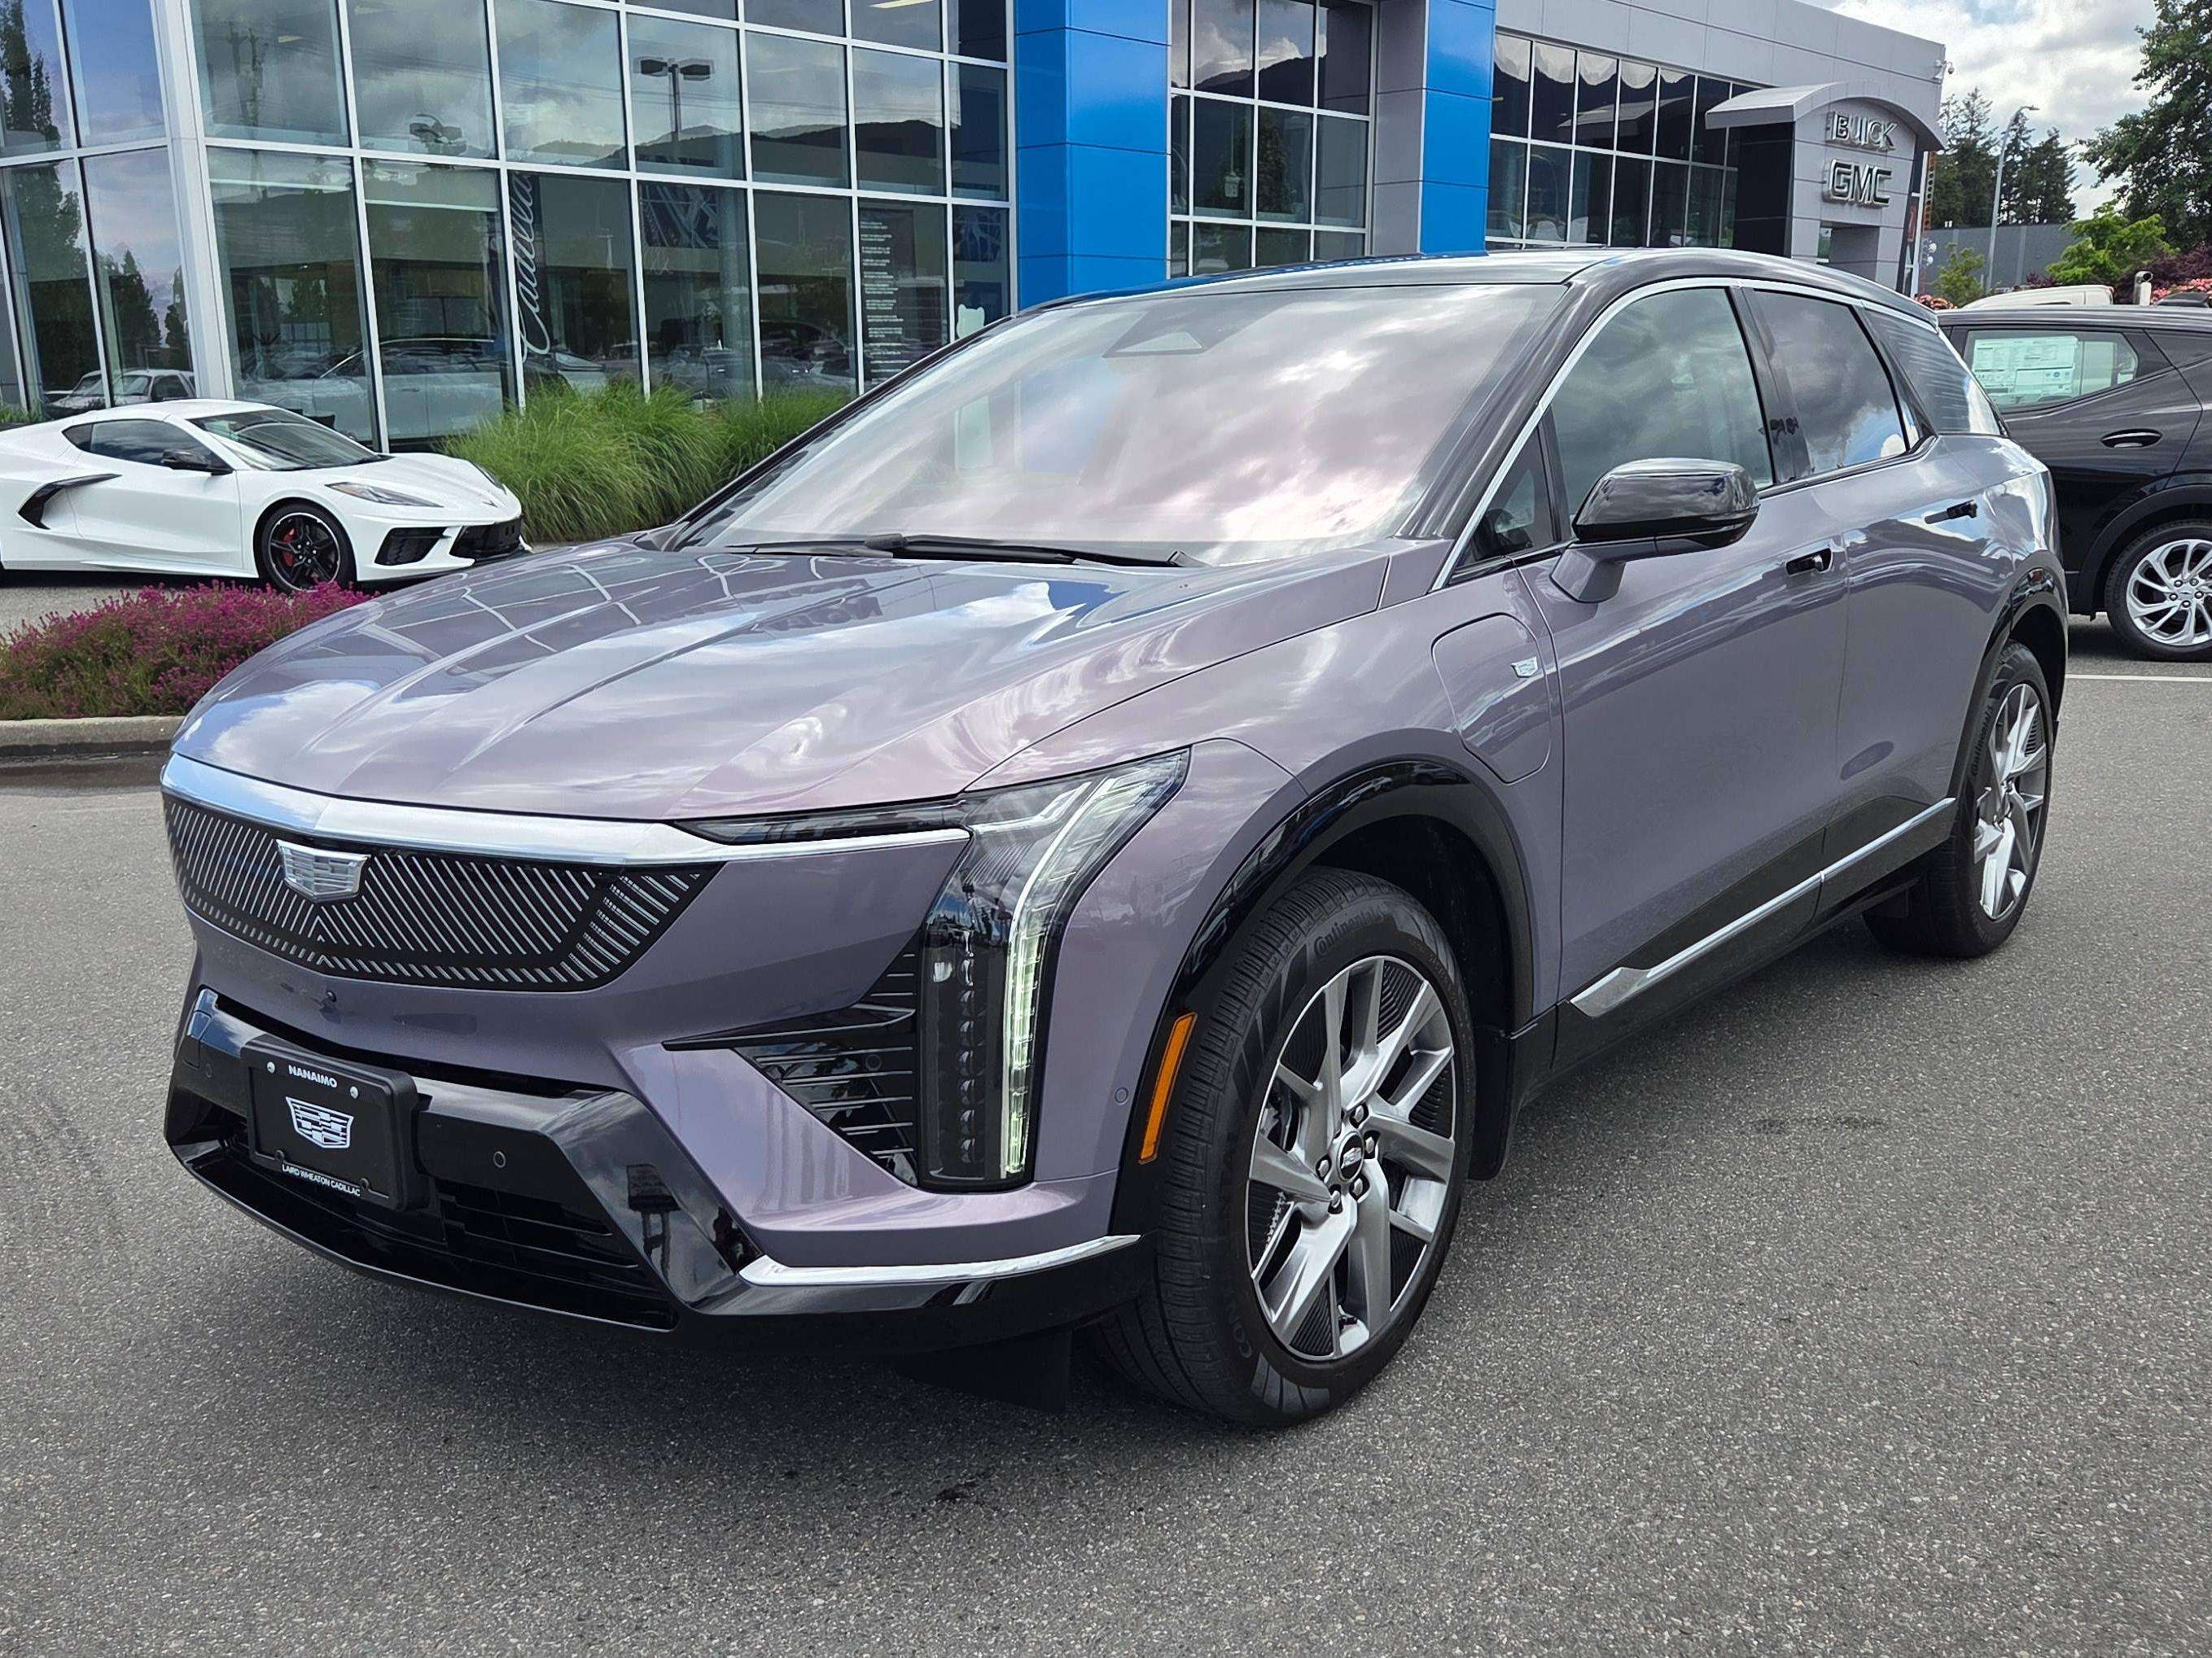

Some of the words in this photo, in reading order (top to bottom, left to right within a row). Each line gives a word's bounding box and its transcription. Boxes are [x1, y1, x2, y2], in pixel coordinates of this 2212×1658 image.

[1831, 112, 1898, 151] BUICK
[1829, 159, 1893, 208] GMC
[510, 173, 550, 364] Cadilla
[288, 1064, 338, 1088] NANAIMO
[282, 1164, 300, 1176] LAIRD
[300, 1170, 331, 1188] WHEATON
[331, 1180, 361, 1197] CADILLAC
